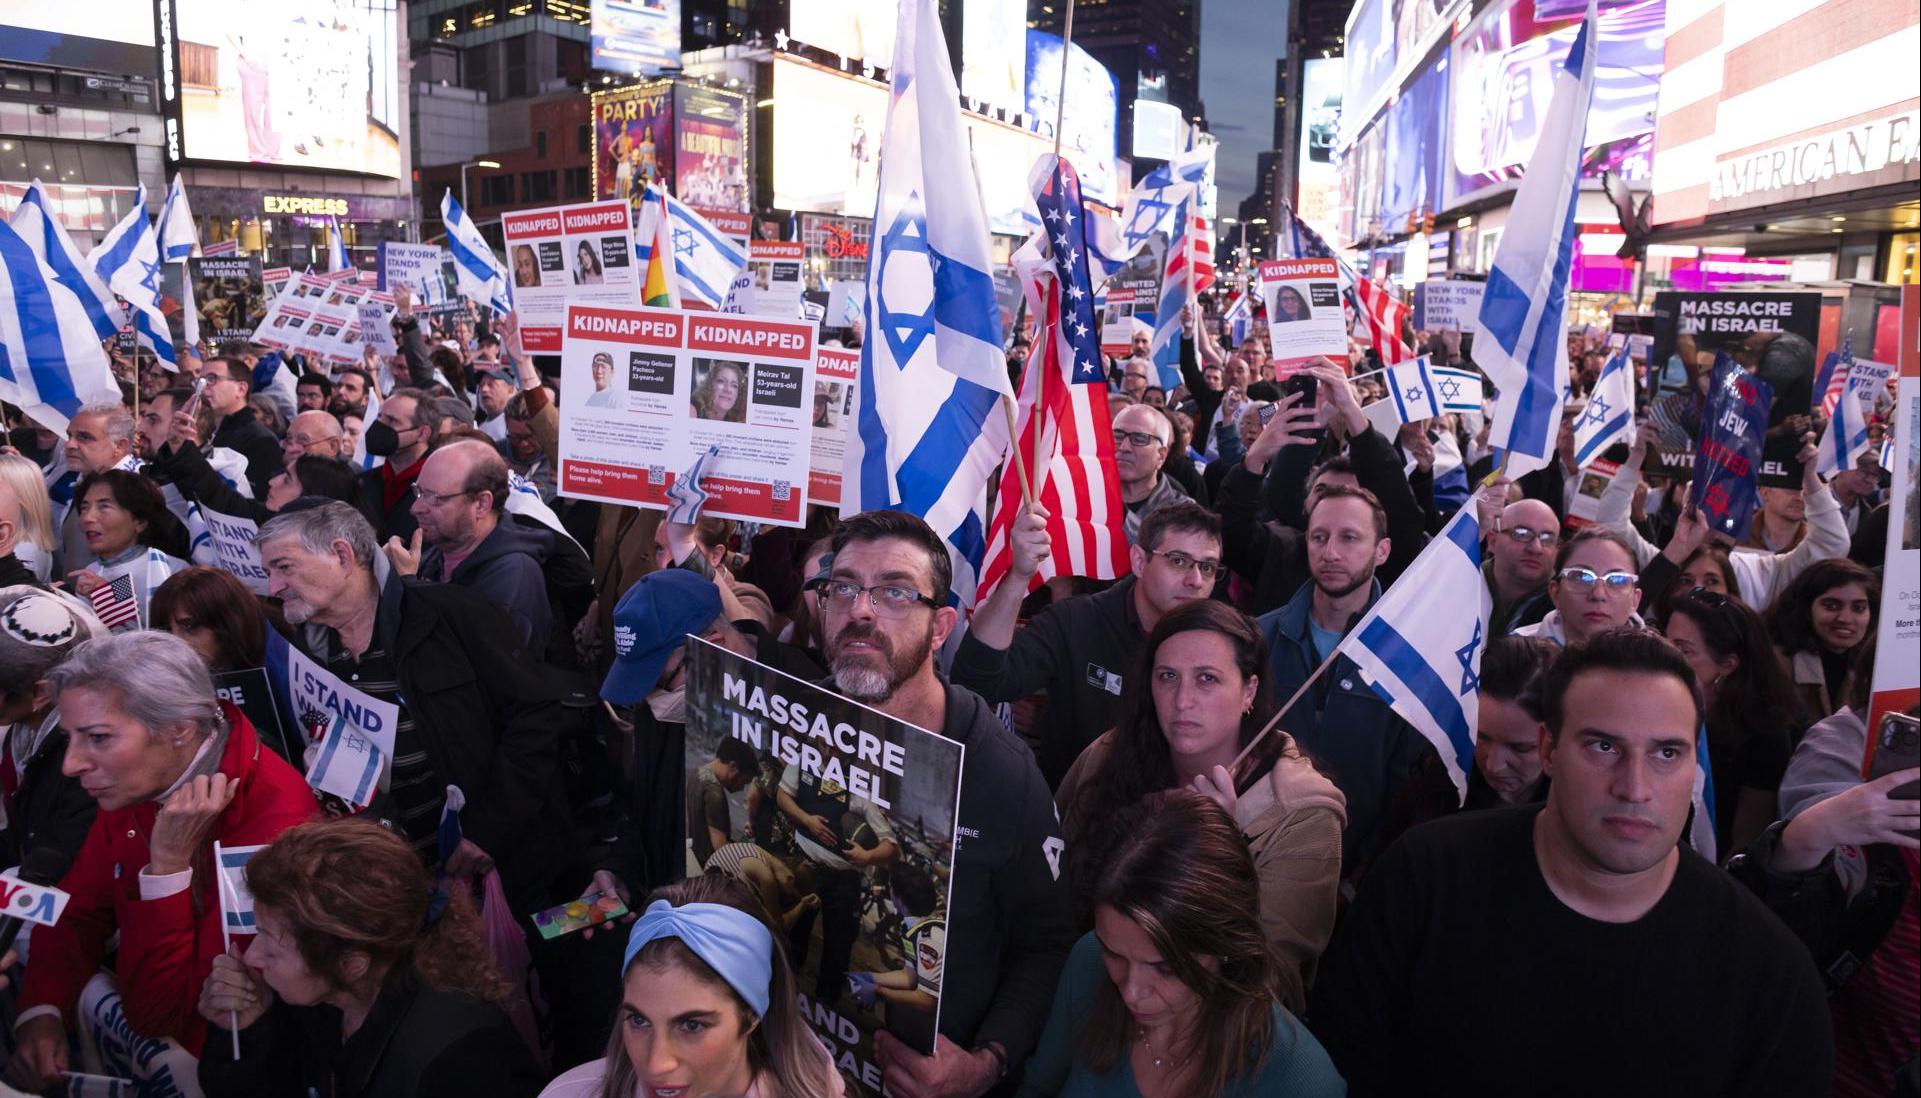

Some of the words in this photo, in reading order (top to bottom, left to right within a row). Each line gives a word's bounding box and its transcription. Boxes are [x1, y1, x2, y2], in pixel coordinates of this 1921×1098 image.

[603, 96, 665, 124] PARTY!
[1711, 126, 1874, 200] AMERICAN
[264, 196, 349, 216] EXPRESS
[508, 218, 559, 234] KIDNAPPED
[567, 211, 624, 228] KIDNAPPED
[387, 248, 406, 257] NEW
[409, 250, 437, 259] YORK
[200, 261, 250, 269] MASSACRE
[387, 259, 421, 269] STANDS
[1264, 264, 1334, 276] KIDNAPPED
[1123, 280, 1155, 288] UNITED
[1428, 286, 1450, 294] NEW
[1455, 286, 1481, 296] YORK
[1428, 305, 1453, 314] WITH
[1680, 301, 1793, 316] MASSACRE
[574, 315, 677, 338] KIDNAPPED
[1685, 318, 1706, 331] IN
[1711, 319, 1784, 333] ISRAEL
[694, 325, 805, 350] KIDNAPPED
[1855, 365, 1889, 378] STAND
[756, 379, 798, 390] 53-years-old
[756, 388, 777, 397] Israeli
[1719, 409, 1749, 437] JEW
[1661, 454, 1696, 467] WIT
[569, 465, 589, 474] Please
[590, 468, 604, 477] help
[604, 470, 620, 480] bring
[622, 472, 638, 480] them
[569, 474, 586, 482] home
[710, 483, 724, 491] help
[725, 485, 742, 494] bring
[744, 487, 760, 496] them
[209, 518, 256, 541] STAND
[294, 662, 299, 682] I
[304, 671, 383, 733] STAND
[723, 672, 905, 777] MASSACRE
[731, 711, 761, 750] IN
[771, 730, 891, 810] ISRAEL
